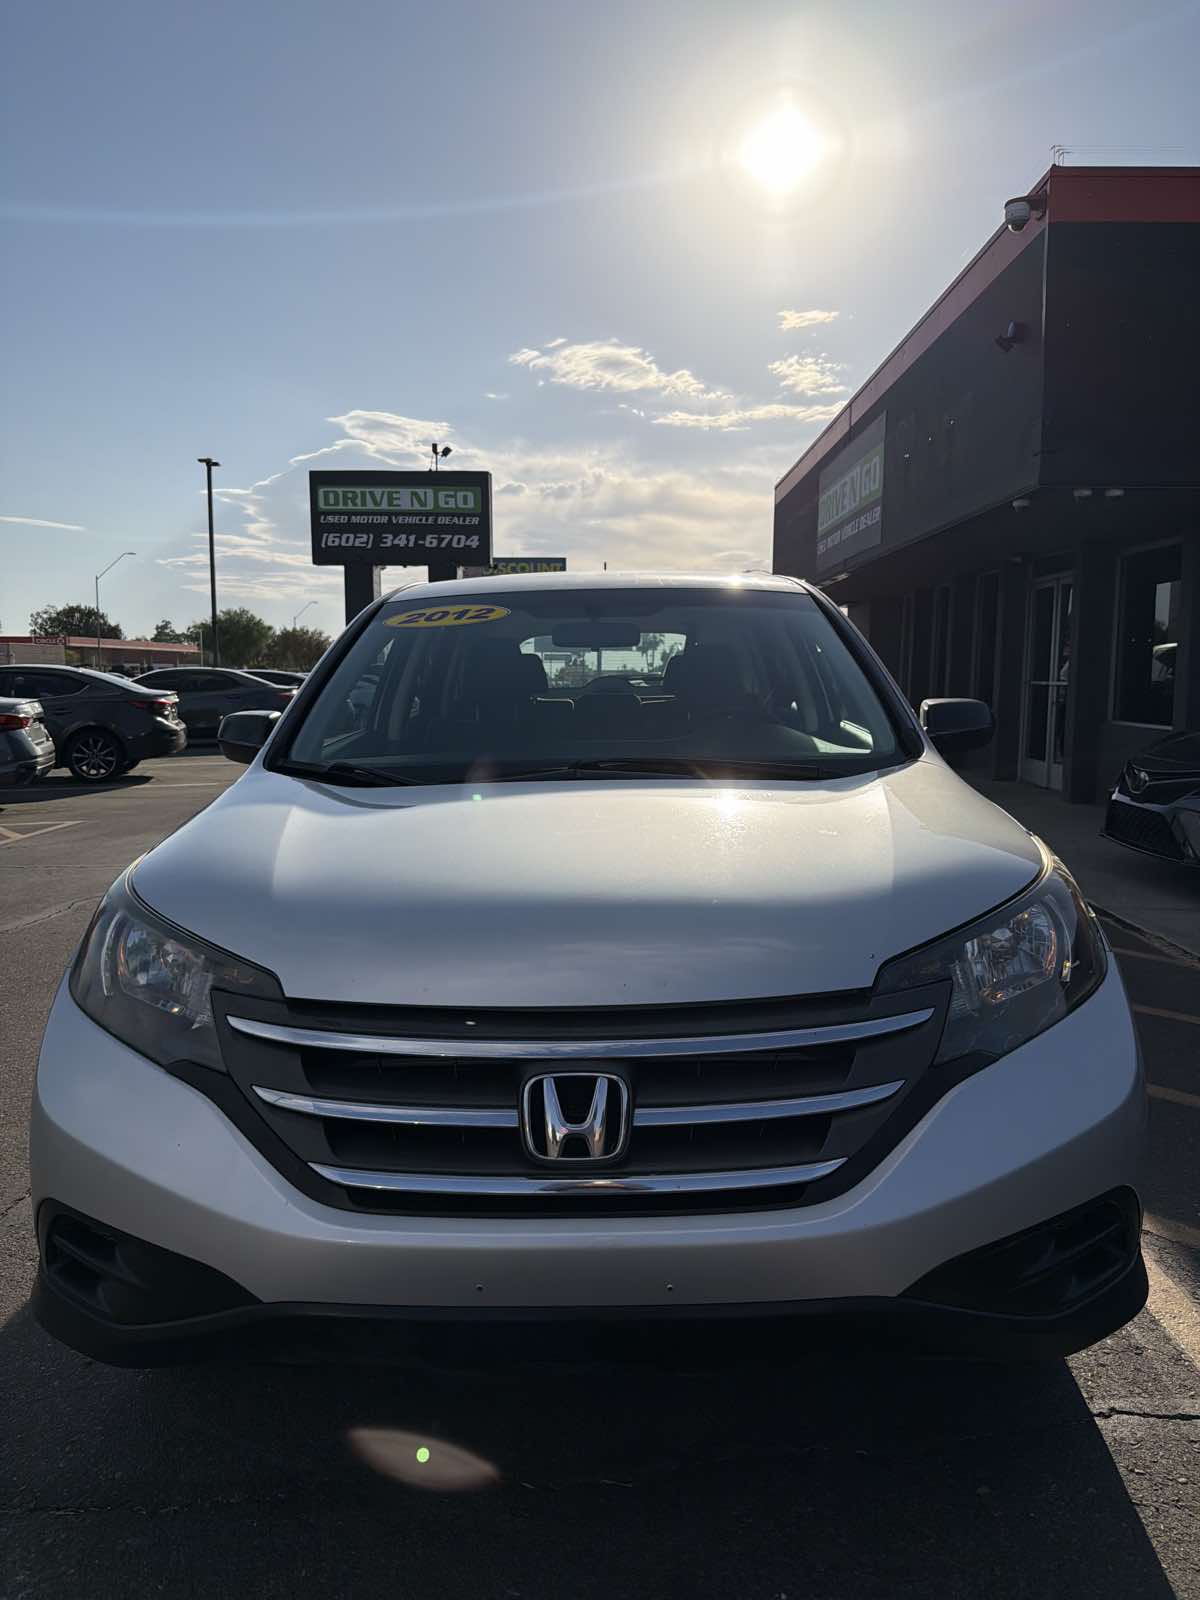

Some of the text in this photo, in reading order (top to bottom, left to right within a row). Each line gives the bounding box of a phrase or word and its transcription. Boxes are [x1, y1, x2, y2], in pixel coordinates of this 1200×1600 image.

[863, 456, 879, 497] GO
[323, 490, 475, 509] DRIVE N GO
[320, 515, 480, 525] USED MOTOR VEHICLE DEALER
[321, 533, 480, 549] (602) 341-6704
[397, 607, 497, 625] 2012
